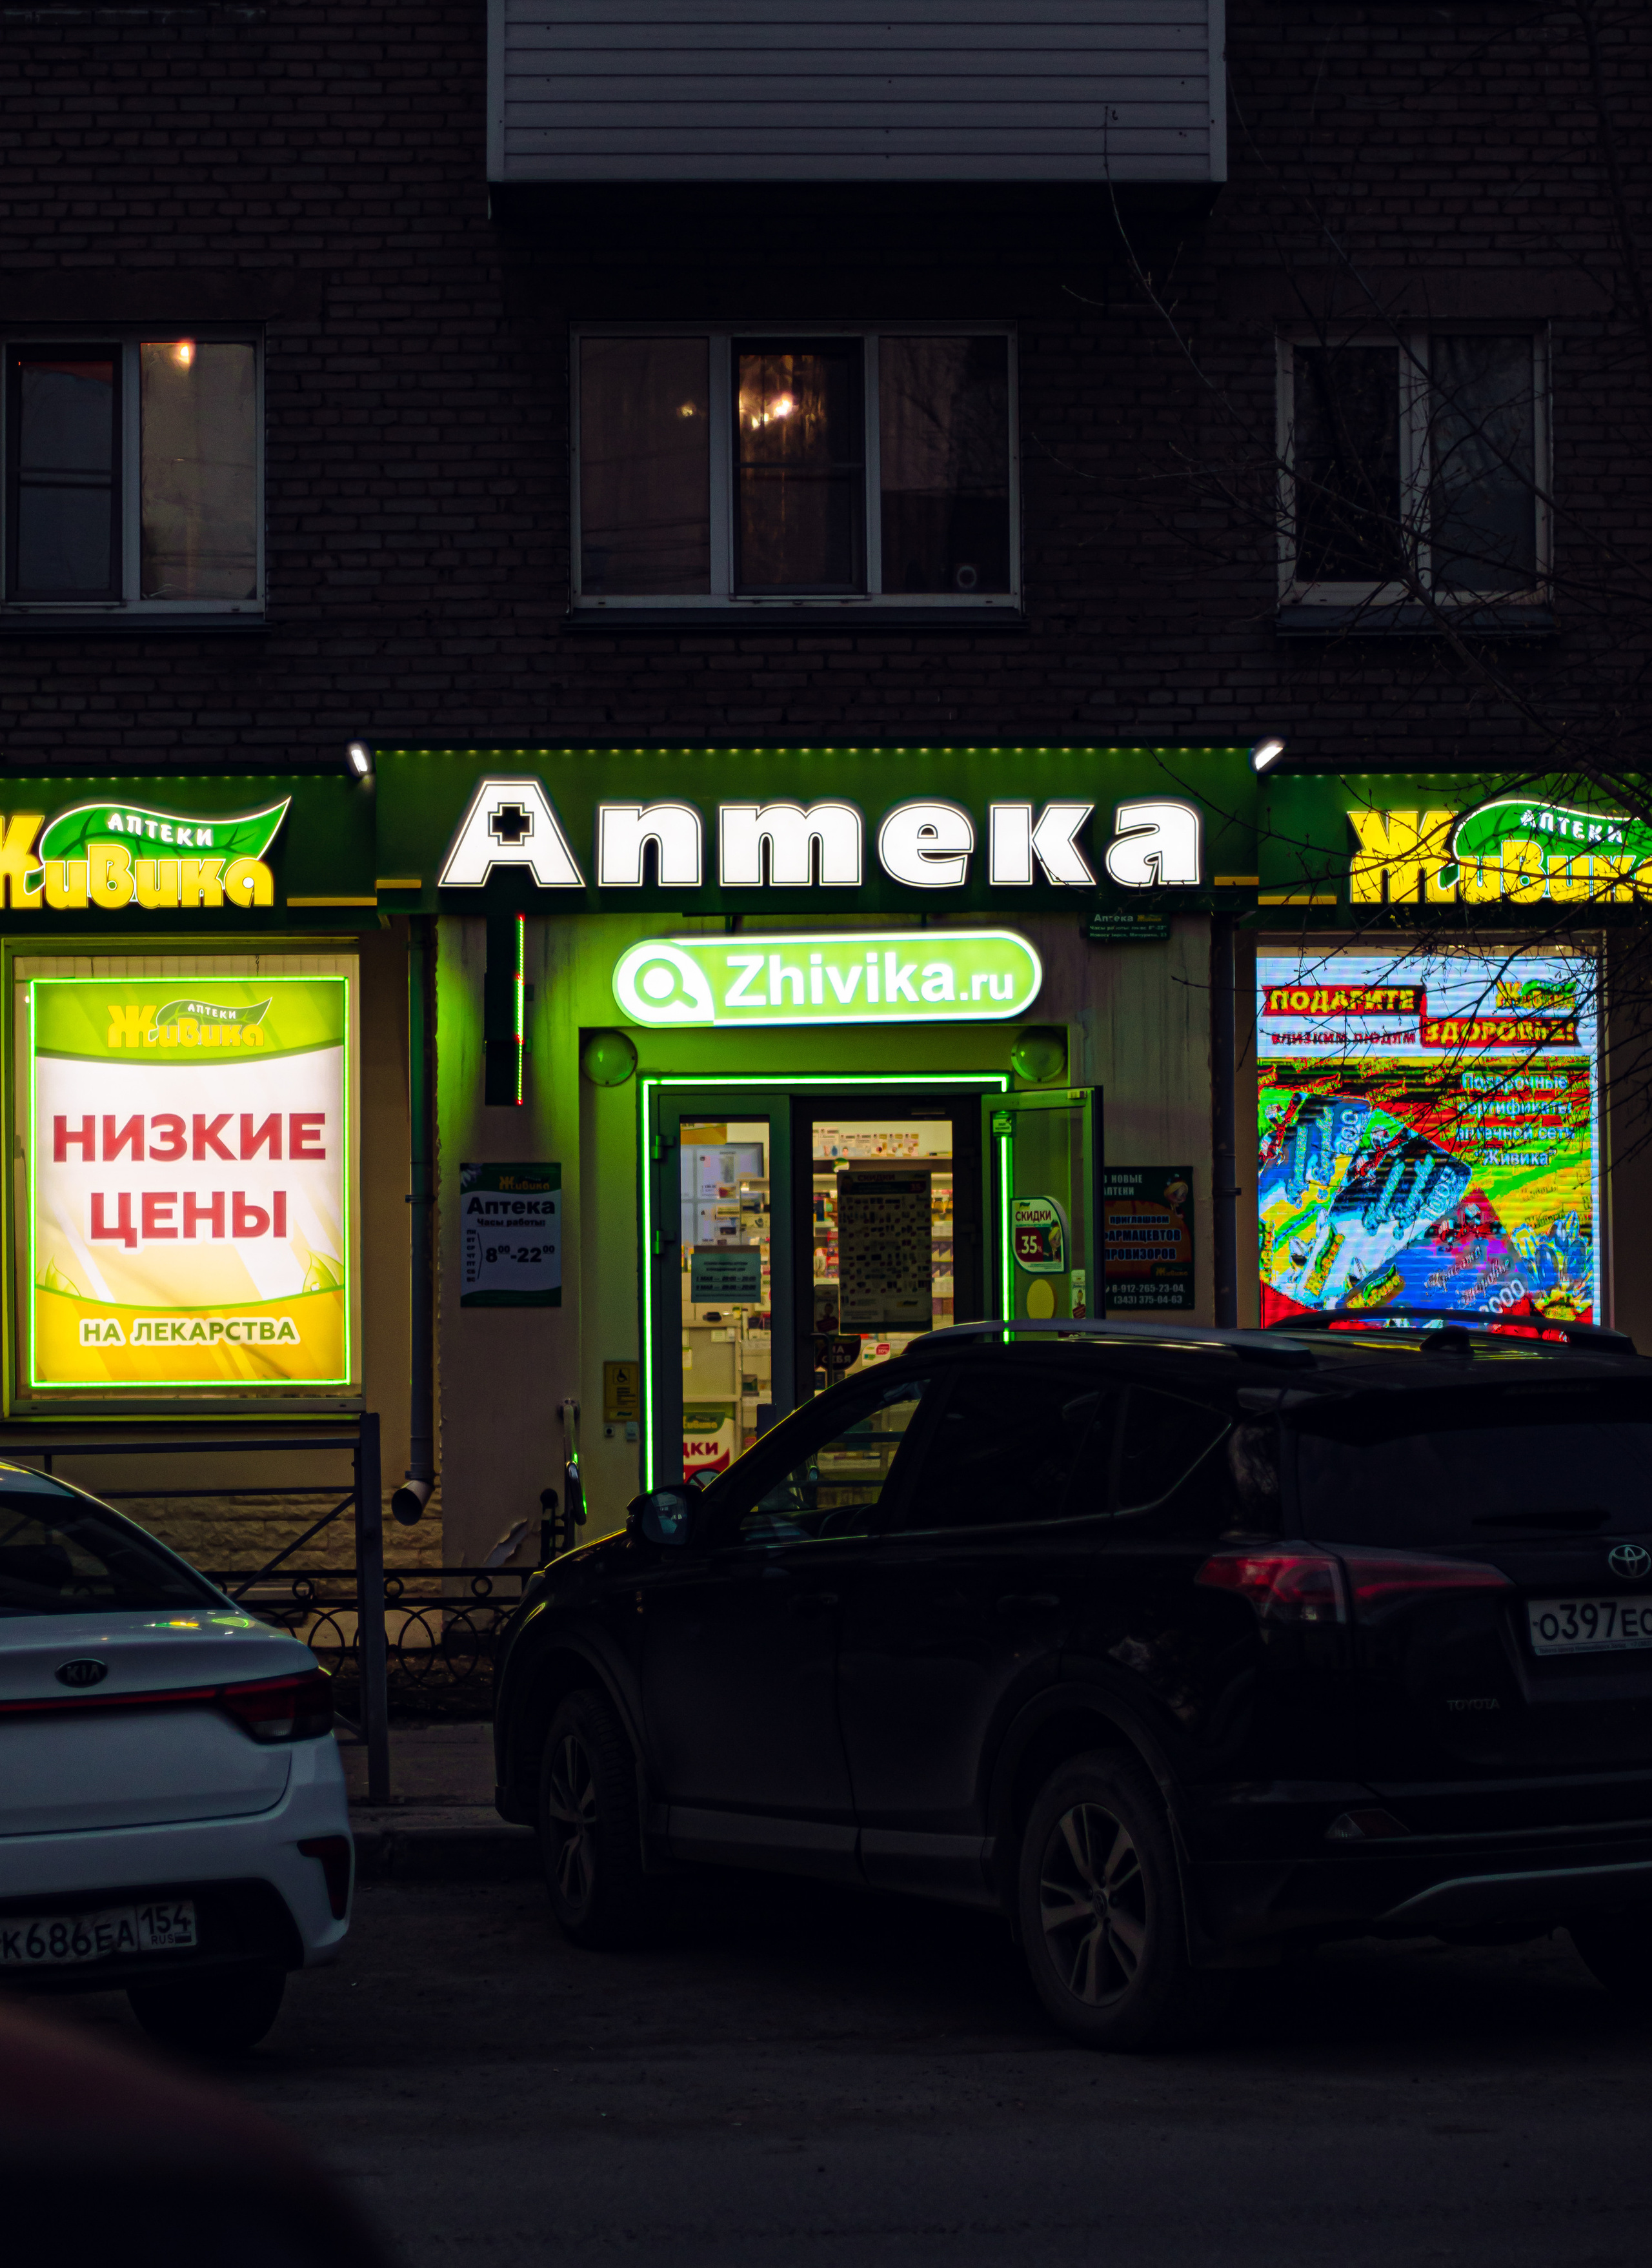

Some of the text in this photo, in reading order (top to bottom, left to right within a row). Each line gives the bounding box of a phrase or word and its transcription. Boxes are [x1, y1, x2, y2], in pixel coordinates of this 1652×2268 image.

[107, 812, 214, 847] АПТЕКИ
[437, 779, 1203, 889] Аптека
[725, 951, 1015, 1007] Zhivika.ru
[187, 1002, 237, 1020] АПТЕКИ
[107, 1004, 265, 1048] Живика
[53, 1112, 327, 1163] НИЗКИЕ
[1111, 1175, 1143, 1184] НОВЫЕ
[467, 1197, 556, 1215] Аптека
[90, 1190, 287, 1249] ЦЕНЫ
[507, 1218, 545, 1226] работы:
[1015, 1210, 1052, 1223] СКИДКИ
[1110, 1216, 1170, 1225] приглашаем
[83, 1321, 296, 1342] НА ЛЕКАРСТВА
[66, 1665, 101, 1682] KIA
[1446, 1698, 1501, 1711] TOYOTA
[140, 1904, 190, 1935] 154
[151, 1932, 174, 1945] RUS
